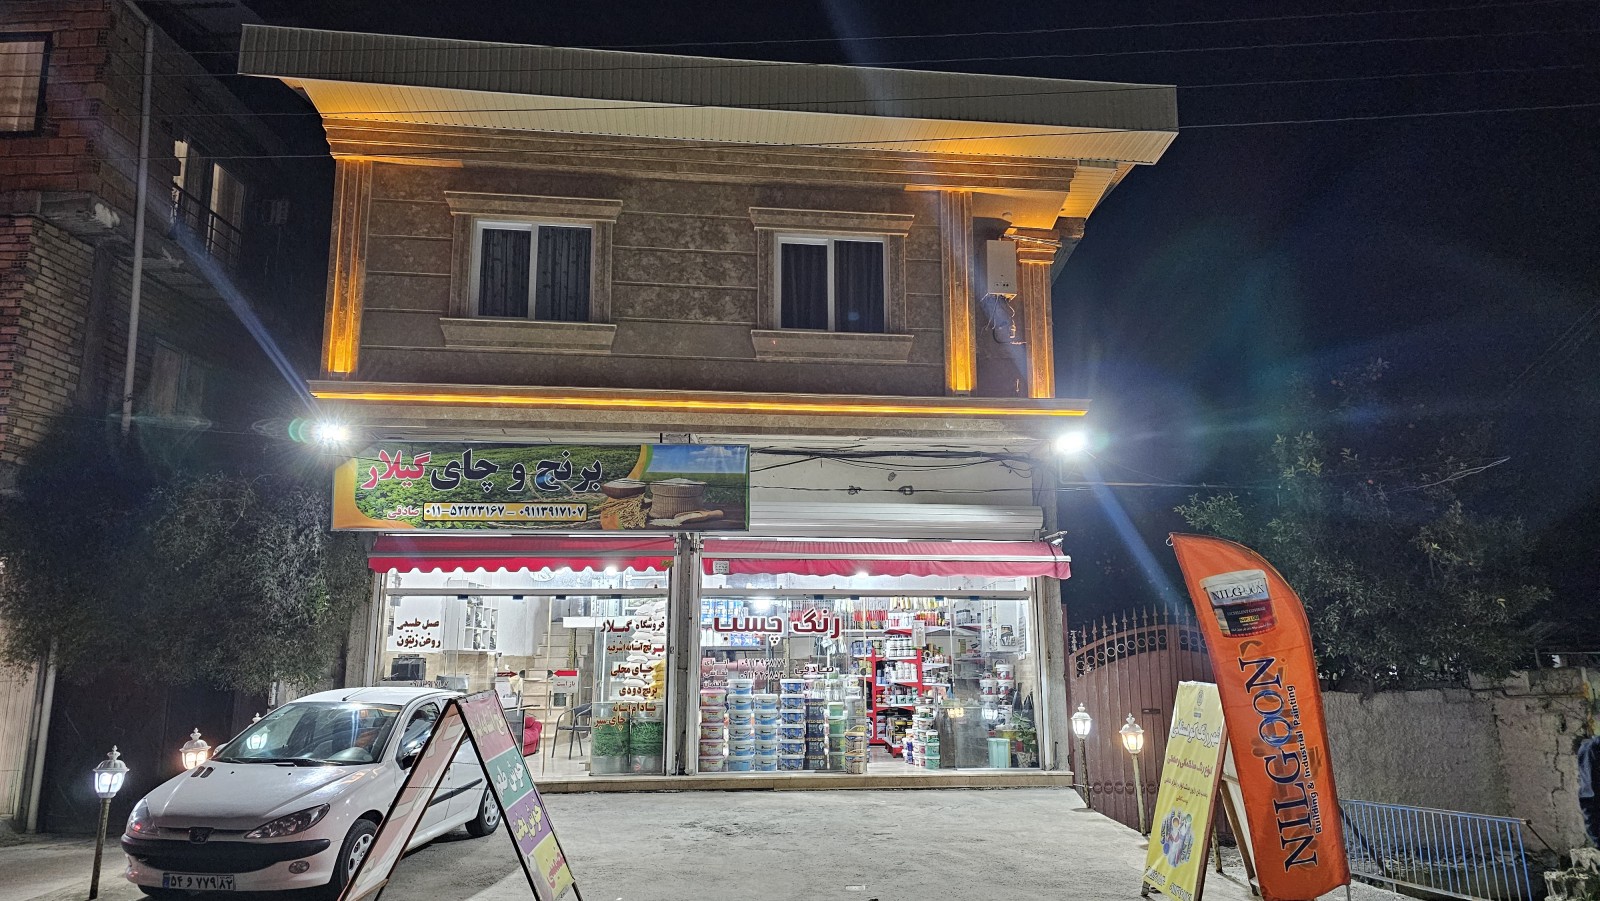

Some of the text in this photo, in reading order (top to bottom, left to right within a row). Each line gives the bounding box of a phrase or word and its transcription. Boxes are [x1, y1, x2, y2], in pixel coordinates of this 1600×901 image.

[360, 448, 603, 493] برنج و چای گیلار
[386, 505, 421, 520] صادقی
[519, 504, 585, 518] ۰۹۱۱۳۹۱۷۱۰۷
[396, 617, 440, 633] عسل طبیعی
[600, 616, 665, 638] فروشگاه گیلار
[713, 608, 840, 645] رنگ چسب
[396, 633, 441, 649] روغن زیتون
[643, 639, 665, 657] برنج
[610, 663, 654, 679] چای محلی
[793, 662, 835, 677] صادقی
[619, 681, 658, 699] برنج دودی
[1237, 656, 1319, 872] NILGOON
[1286, 685, 1323, 834] Building & Industrial Painting
